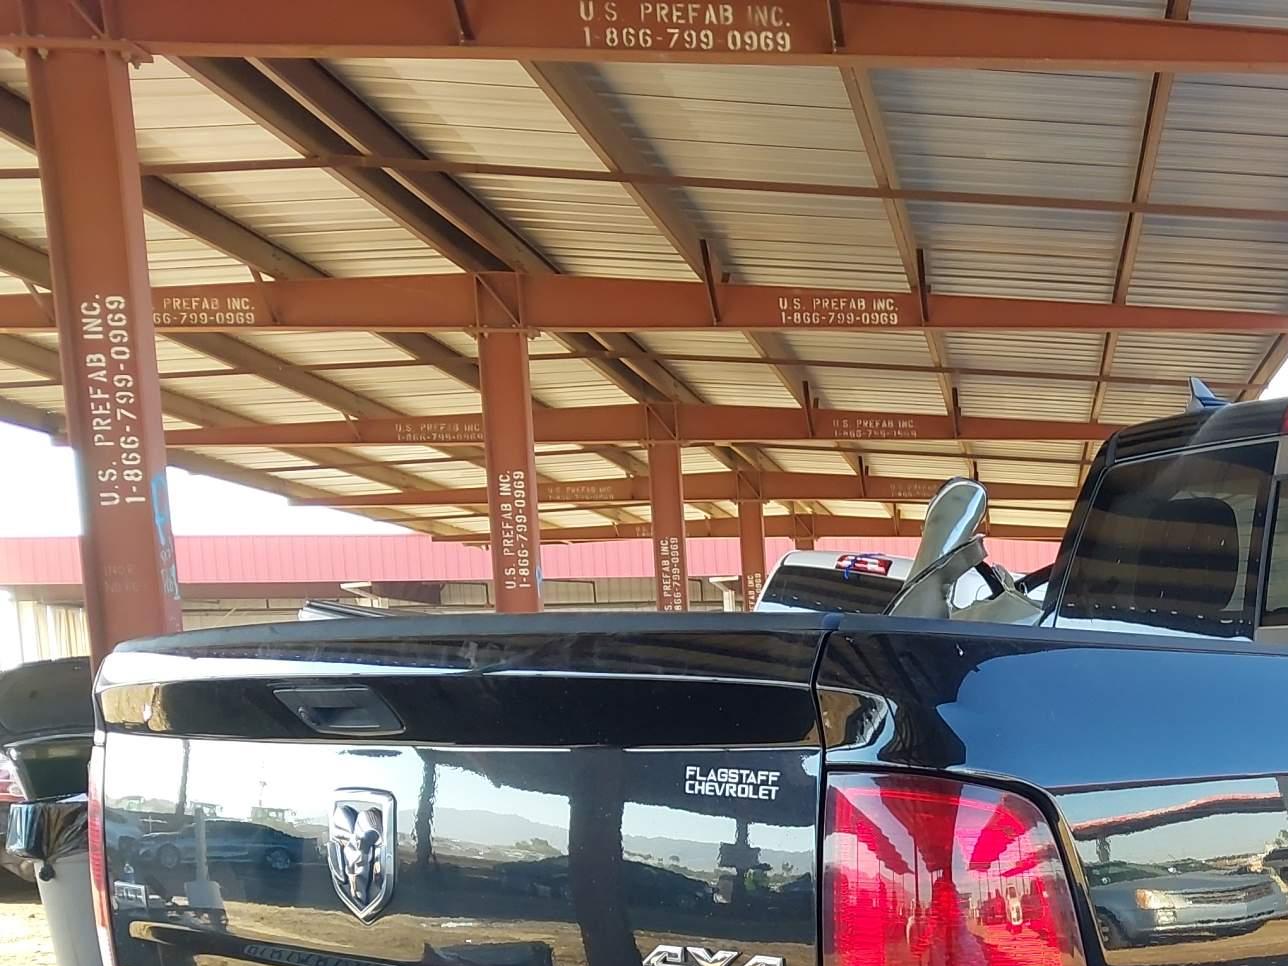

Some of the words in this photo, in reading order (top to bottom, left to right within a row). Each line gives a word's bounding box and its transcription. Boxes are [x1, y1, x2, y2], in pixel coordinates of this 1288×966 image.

[640, 4, 733, 25] PREFAB
[748, 5, 791, 27] INC.
[81, 294, 104, 340] INC.
[163, 297, 219, 311] PREFAB
[227, 297, 255, 311] INC.
[813, 298, 866, 311] PREFAB
[873, 298, 898, 312] INC.
[781, 311, 898, 325] 1-866-799-0969
[86, 353, 115, 446] PREFAB
[105, 295, 147, 503] 1-866-799-0969
[98, 461, 121, 506] U.S.
[499, 470, 512, 496] INC.
[501, 503, 515, 556] PREFAB
[513, 470, 531, 588] 1-866-799-0969
[685, 766, 780, 786] FLAGSTAFF
[685, 779, 780, 800] CHEVROLET
